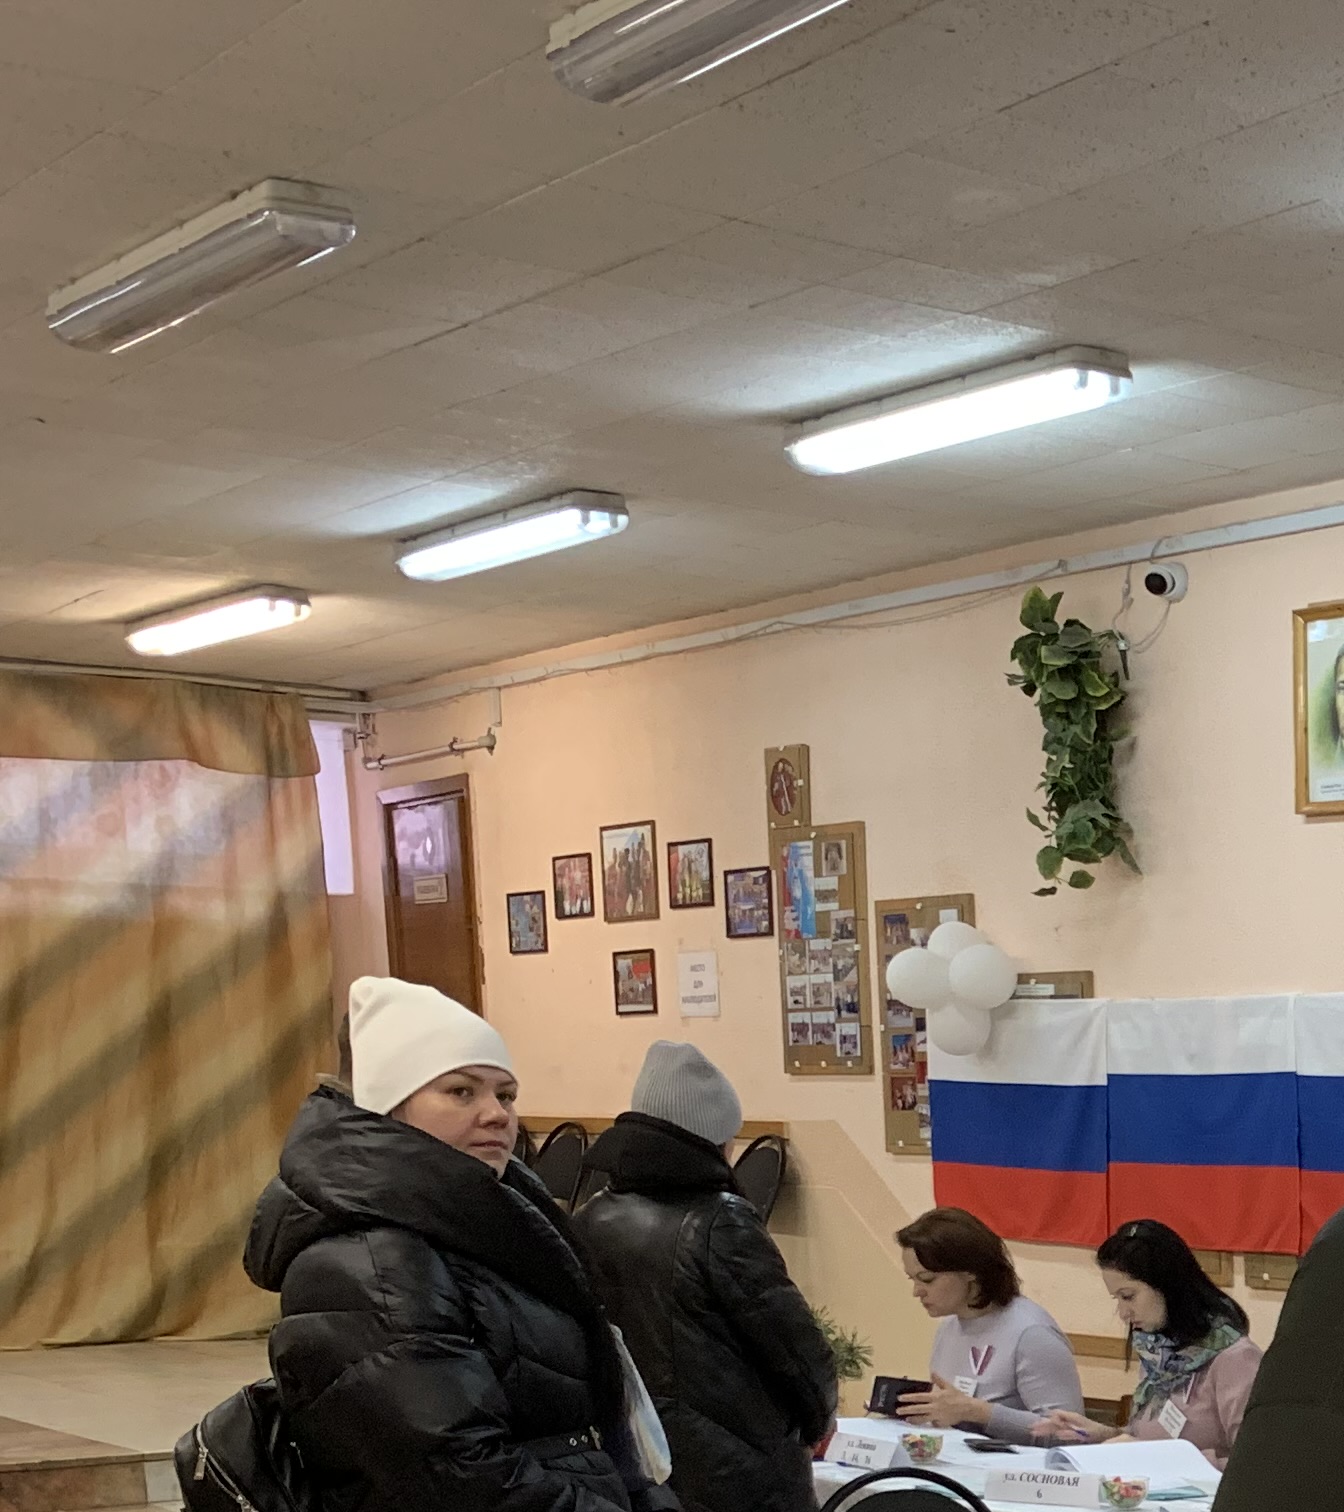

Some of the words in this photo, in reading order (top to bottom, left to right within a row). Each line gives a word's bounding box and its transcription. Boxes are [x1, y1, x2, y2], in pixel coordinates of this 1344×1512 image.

[1002, 1473, 1017, 1484] ул.
[1019, 1472, 1080, 1487] СОСНОВАЯ
[1036, 1488, 1043, 1499] 6
